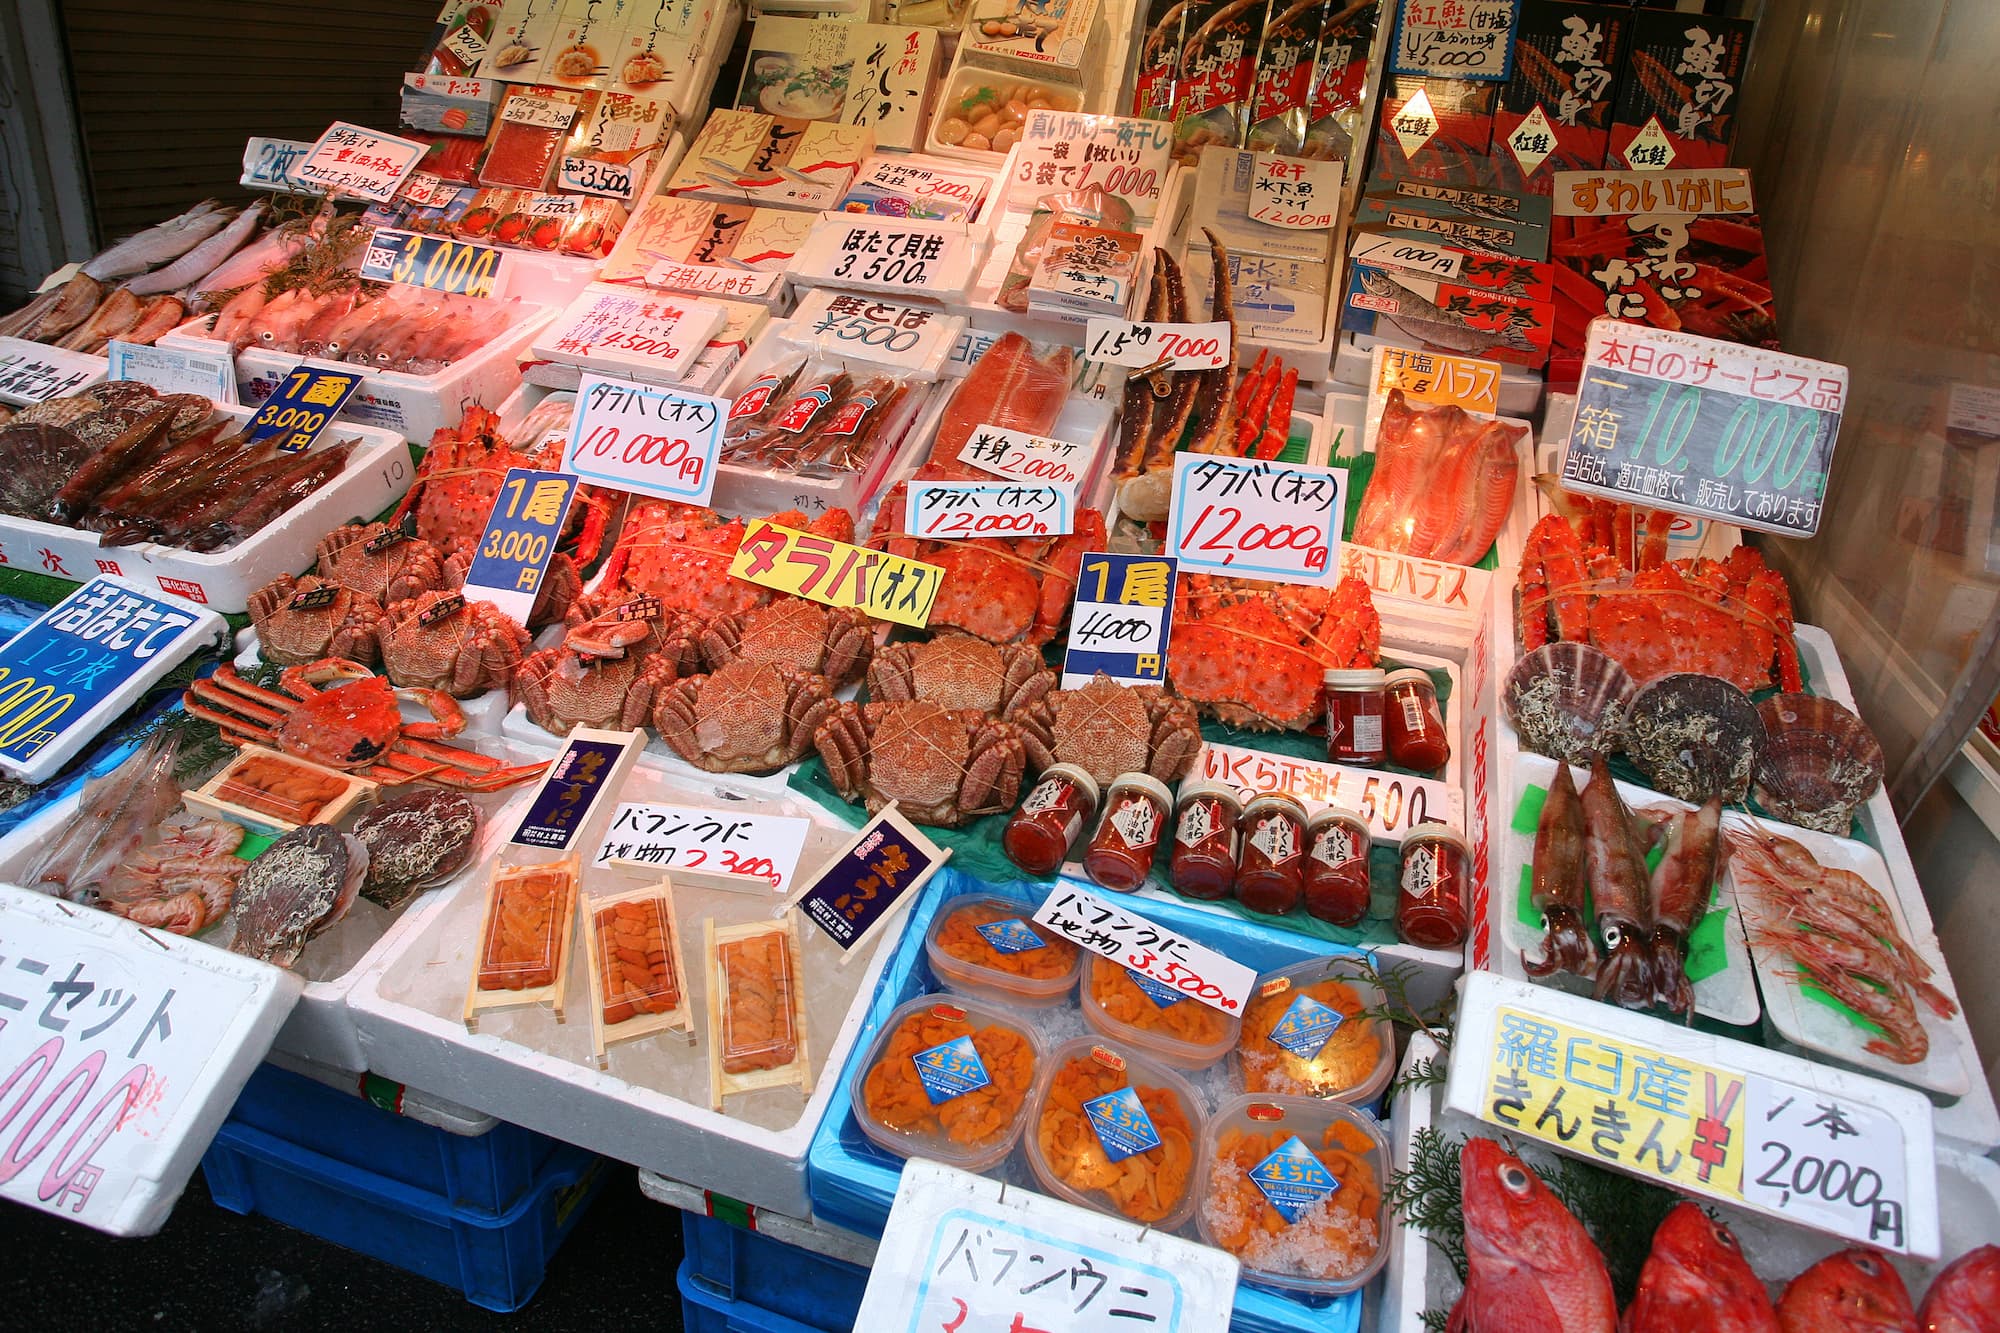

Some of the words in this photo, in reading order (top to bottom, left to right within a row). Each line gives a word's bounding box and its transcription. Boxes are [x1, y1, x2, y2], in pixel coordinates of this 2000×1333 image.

[1215, 33, 1246, 96] 朝いか
[1270, 38, 1300, 106] 朝いか
[1322, 38, 1352, 104] 朝いか
[1554, 13, 1612, 126] 鮭切身
[1675, 24, 1734, 140] 鮭切身
[326, 129, 379, 150] 当店は
[1028, 111, 1171, 152] 真いかの一夜干し
[1395, 116, 1430, 138] 紅鮭
[1512, 130, 1549, 156] 紅鮭
[318, 148, 402, 178] 二重価格を
[1038, 141, 1069, 161] 一袋
[1629, 142, 1667, 167] 紅鮭
[303, 164, 397, 198] つけておりません
[880, 161, 933, 182] お刺身用
[1258, 159, 1308, 182] 一夜干
[1271, 195, 1311, 212] コマイ
[1571, 177, 1750, 214] ずわいがに
[841, 228, 945, 261] ほたて貝柱
[834, 253, 927, 285] 3.500円
[825, 296, 934, 329] 鮭とば
[1444, 294, 1543, 328] 昆布巻
[812, 311, 921, 354] ¥500
[1385, 348, 1435, 376] 甘塩
[1597, 338, 1843, 413] 本日のサービス品
[1432, 360, 1498, 404] ハラス
[590, 381, 719, 434] タラバ(オス)
[286, 433, 313, 450] 円
[571, 425, 705, 486] 10.000円
[969, 434, 1012, 464] 半身
[504, 476, 573, 526] 1尾
[924, 484, 1059, 513] タラバ(オス)
[1193, 458, 1339, 513] タラバ(オス)
[482, 528, 547, 565] 3,000
[517, 568, 540, 592] 円
[739, 520, 943, 622] タラバ(オス)
[1085, 560, 1171, 609] 1尾
[48, 582, 194, 659] 活ほたて
[1076, 611, 1153, 648] 4,000
[19, 637, 117, 692] 12枚
[1134, 655, 1162, 677] 円
[612, 806, 754, 847] バフンうに
[1135, 806, 1154, 844] いくら
[1194, 802, 1207, 840] いくら
[1278, 815, 1291, 858] いくら
[1334, 831, 1347, 862] いくら
[1419, 851, 1433, 889] いくら
[1046, 910, 1123, 957] 地物
[1054, 892, 1192, 963] バフンうに
[0, 955, 177, 1060] ニセット
[926, 1049, 980, 1081] 生うに
[1495, 1013, 1693, 1120] 羅臼産
[0, 1018, 148, 1214] 000円
[1095, 1100, 1152, 1138] 生うに
[1491, 1067, 1684, 1177] きんきん
[1262, 1161, 1326, 1186] 生うに
[1754, 1140, 1907, 1248] 2,000円
[936, 1227, 1158, 1323] バフンウニ
